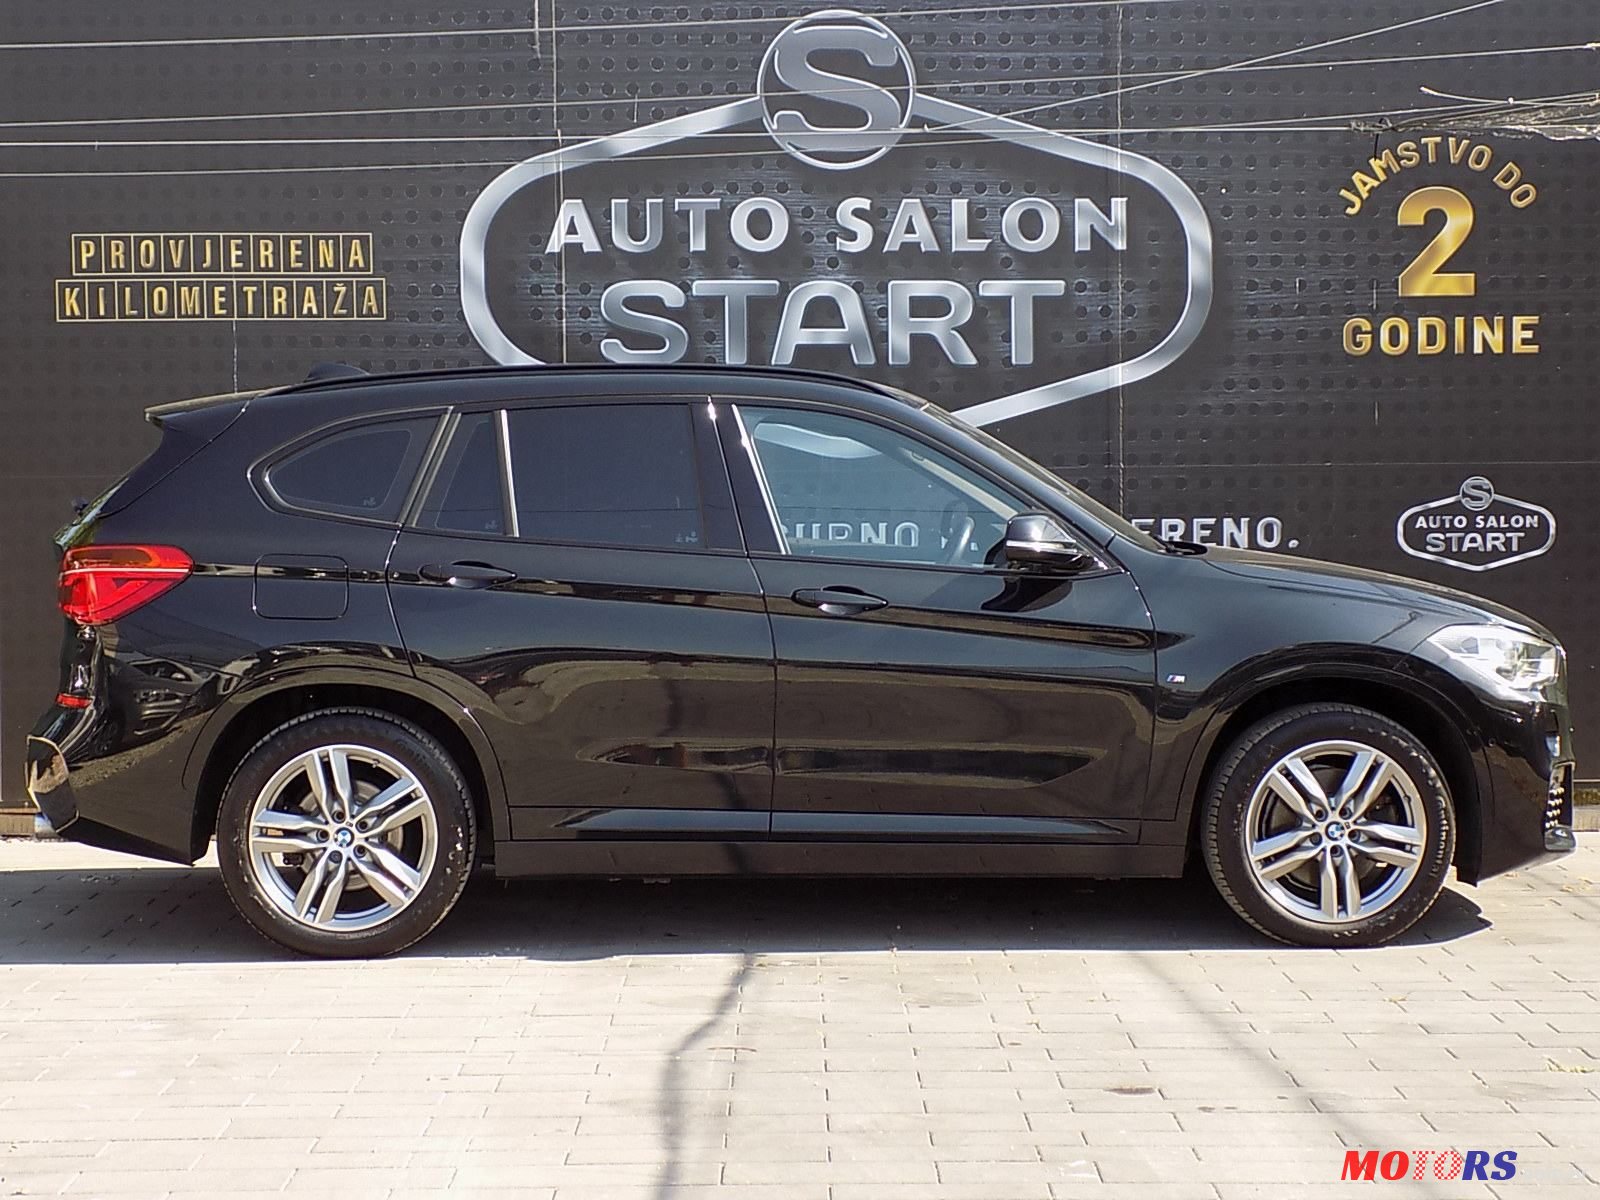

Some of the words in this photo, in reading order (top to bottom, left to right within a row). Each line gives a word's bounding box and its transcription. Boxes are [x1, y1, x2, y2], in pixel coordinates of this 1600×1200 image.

[771, 25, 903, 152] S
[1338, 136, 1493, 216] JAMSTVO
[1493, 161, 1538, 209] DO
[545, 196, 790, 254] AUTO
[834, 196, 1128, 253] SALON
[1397, 186, 1476, 297] 2
[79, 238, 366, 269] PROVJERENA
[64, 282, 380, 317] KILOMETRAŽA
[600, 279, 1066, 366] START
[1342, 315, 1541, 356] GODINE
[1414, 515, 1468, 529] AUTO
[1475, 514, 1539, 529] SALON
[1425, 531, 1526, 553] START
